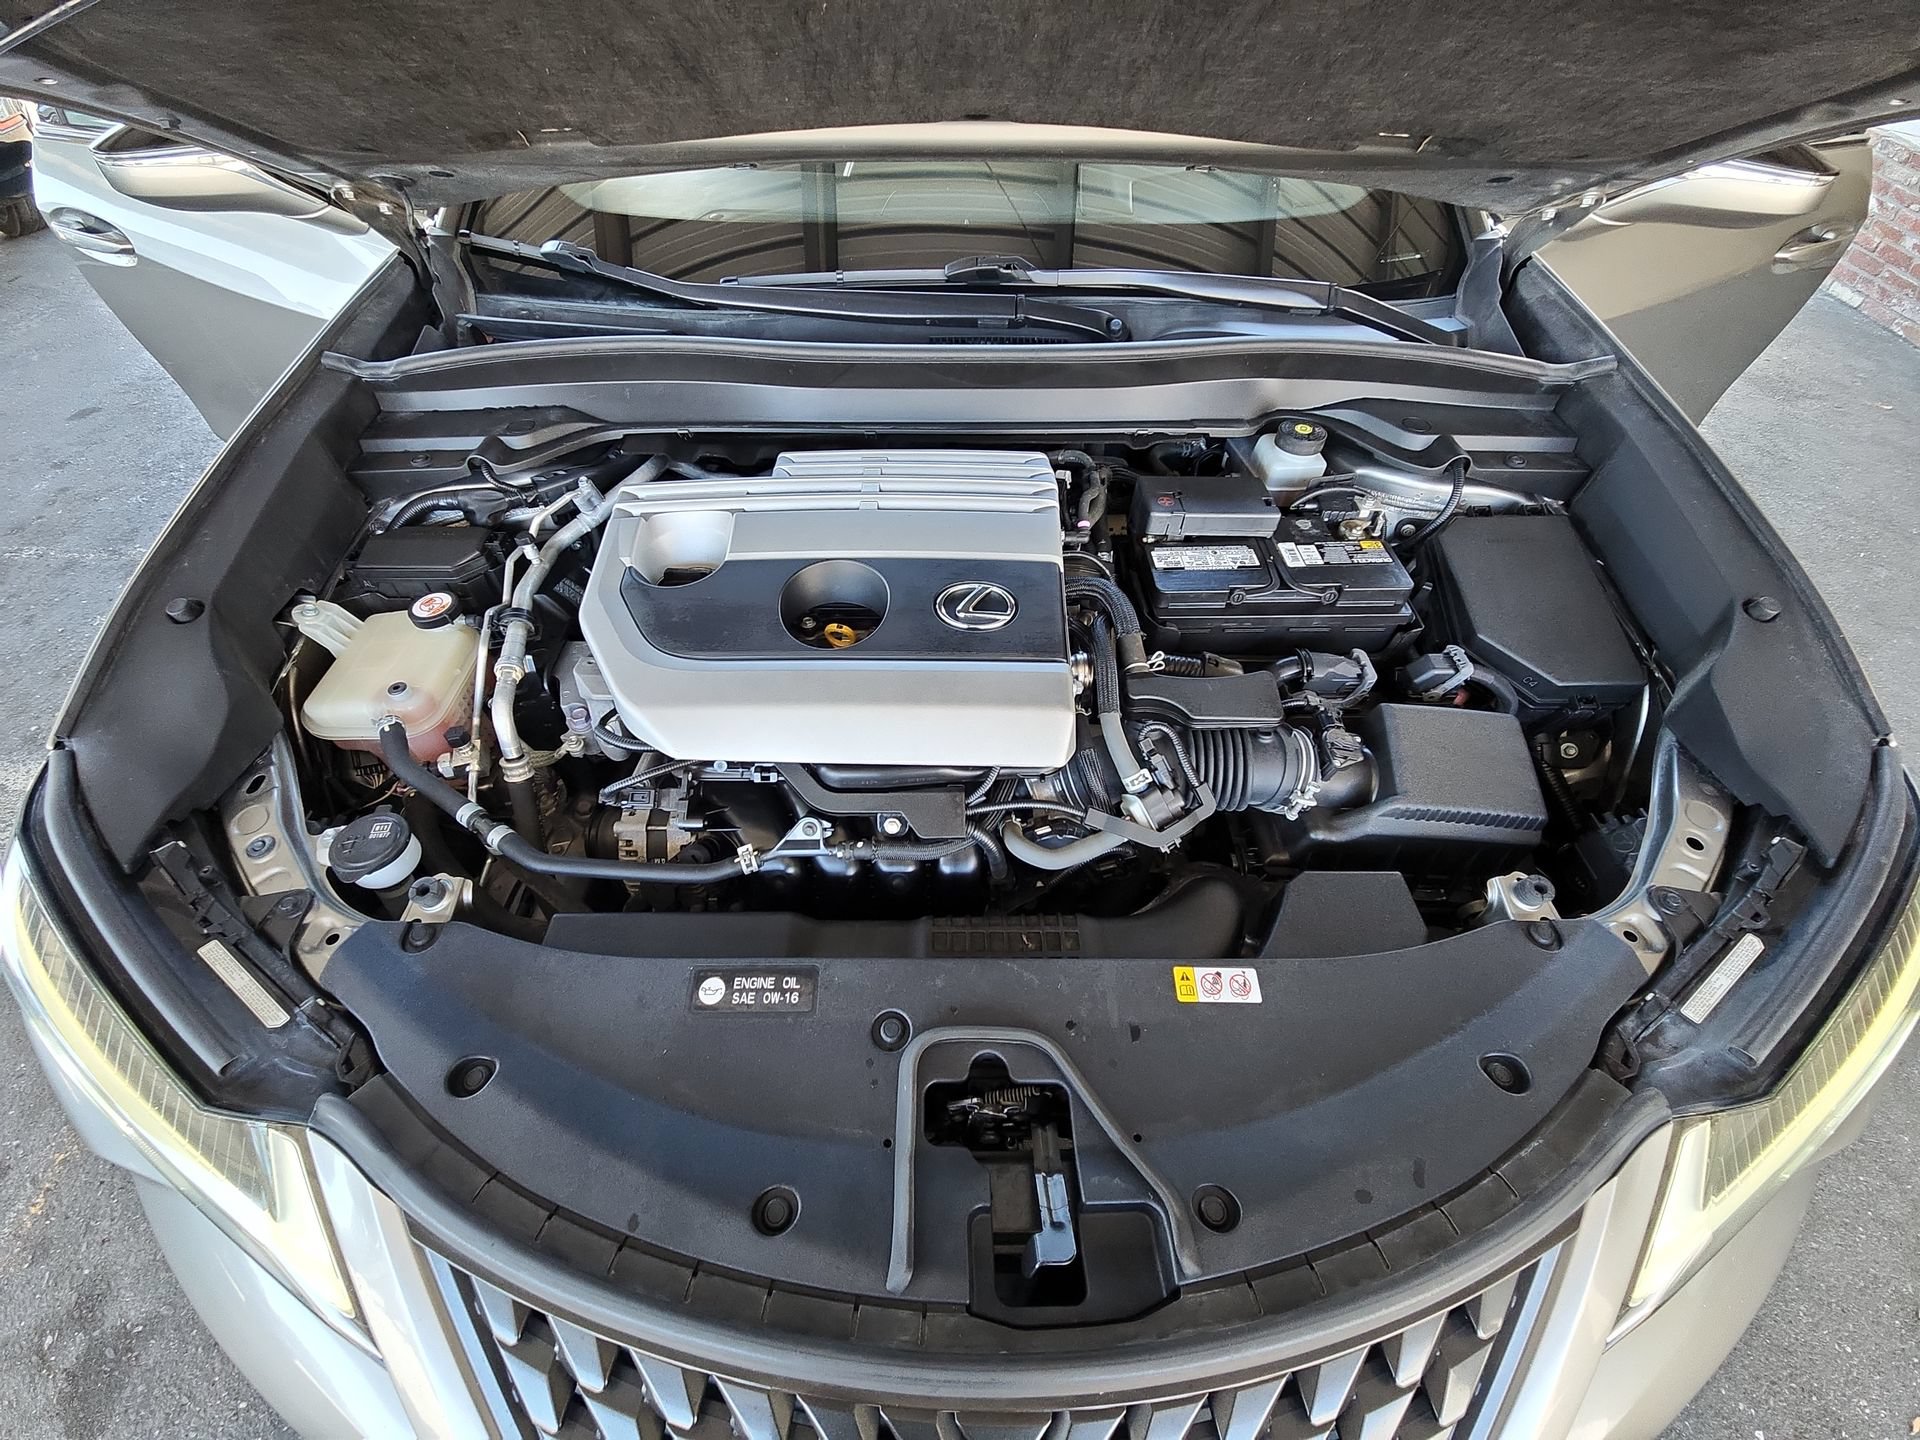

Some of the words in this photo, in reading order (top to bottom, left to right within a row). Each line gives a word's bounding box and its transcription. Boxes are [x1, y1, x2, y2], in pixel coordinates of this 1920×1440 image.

[733, 977, 776, 989] ENGINE
[782, 977, 801, 989] OIL
[731, 992, 756, 1004] SAE
[763, 992, 799, 1004] 0W-16
